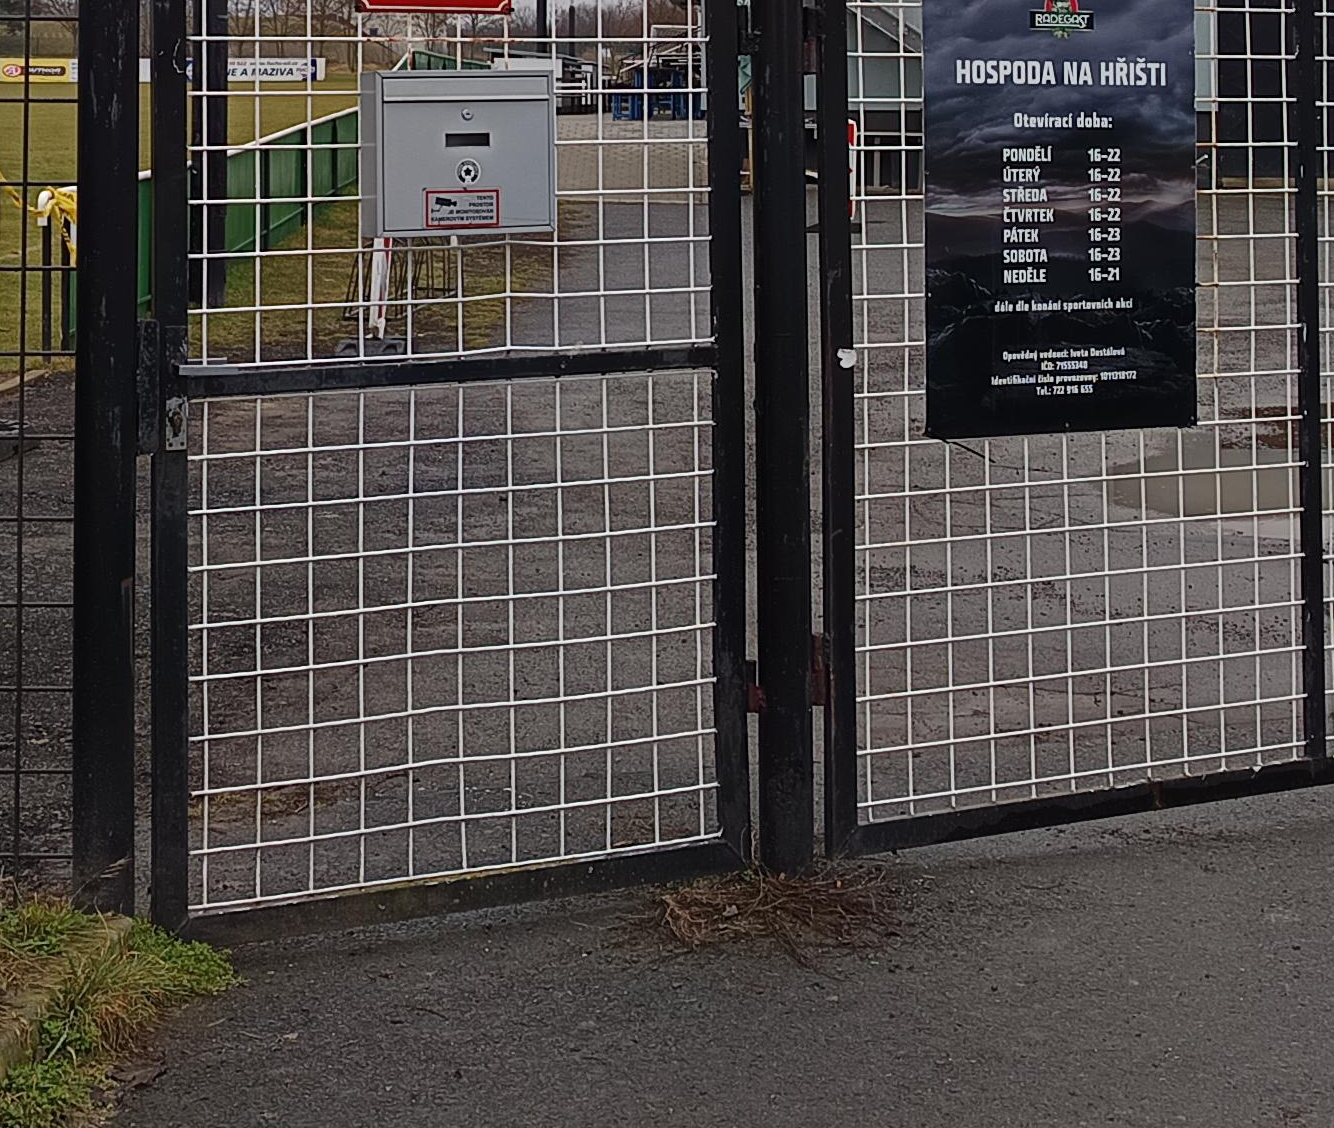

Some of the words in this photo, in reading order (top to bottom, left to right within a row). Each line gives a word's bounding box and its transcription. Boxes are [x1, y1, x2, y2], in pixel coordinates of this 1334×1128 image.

[1035, 13, 1090, 29] RADEGAST
[955, 59, 1057, 85] HOSPODA
[1063, 61, 1093, 86] NA
[1100, 57, 1167, 86] HŘIŠTI
[1013, 112, 1073, 129] Otevírací
[1076, 111, 1113, 129] doba:
[1002, 145, 1052, 162] PONDĚLÍ
[1002, 166, 1041, 182] ÚTERÝ
[1002, 186, 1048, 203] STŘEDA
[1003, 206, 1055, 223] ČTVRTEK
[1003, 226, 1039, 243] PÁTEK
[1003, 248, 1048, 263] SOBOTA
[1003, 266, 1047, 284] NEDĚLE
[994, 300, 1013, 313] dále
[1015, 300, 1029, 312] dle
[1031, 299, 1061, 312] konání
[1063, 297, 1114, 313] sportovních
[1115, 297, 1133, 309] akcí
